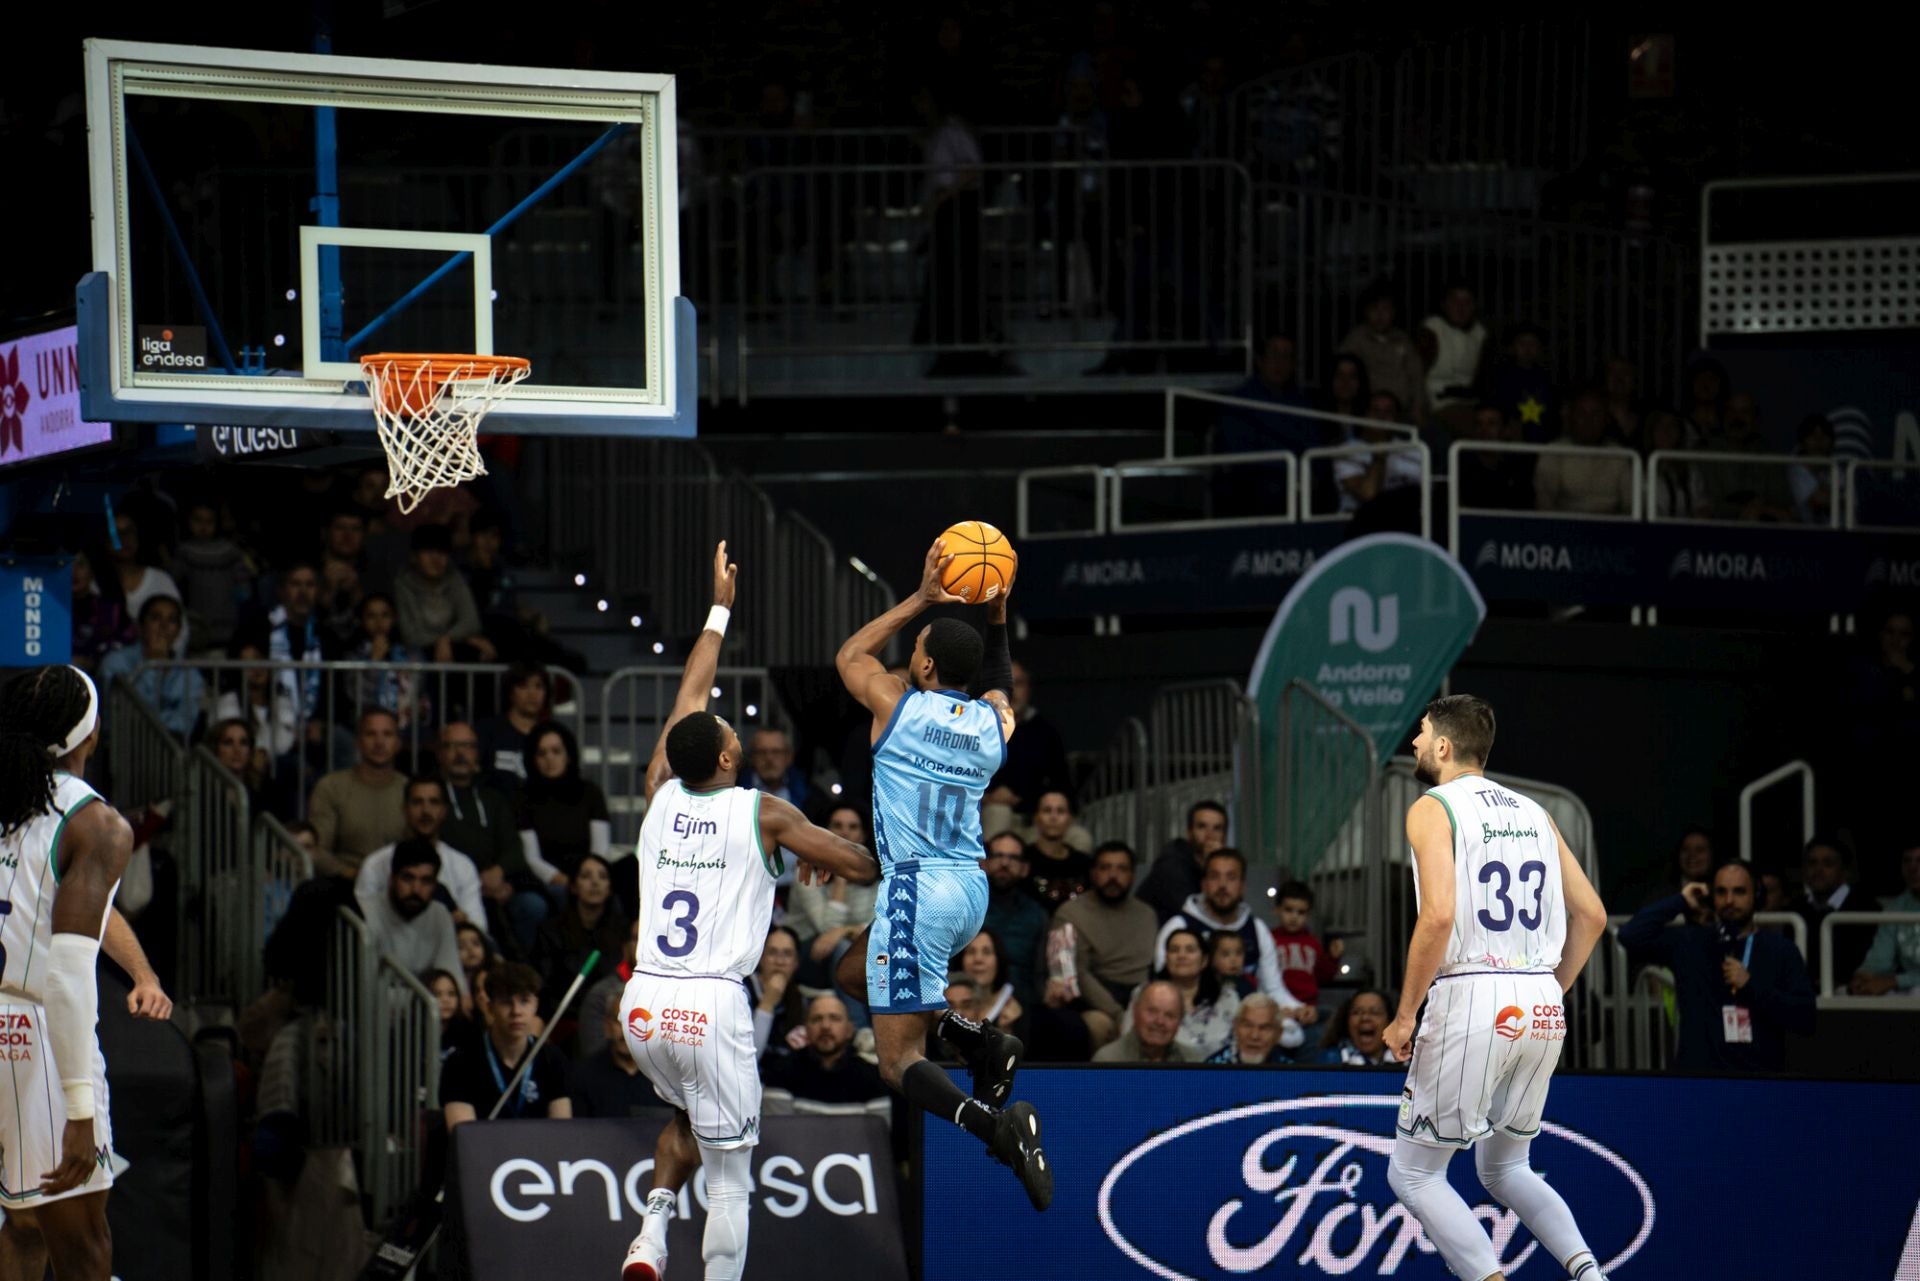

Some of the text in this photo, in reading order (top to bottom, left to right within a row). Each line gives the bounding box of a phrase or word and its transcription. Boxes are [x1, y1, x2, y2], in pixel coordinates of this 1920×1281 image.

[142, 337, 171, 353] liga
[143, 353, 205, 367] endesa
[23, 577, 43, 656] MONDO
[1317, 663, 1411, 682] Andorra
[1347, 685, 1405, 705] Vella
[923, 726, 980, 751] HARDING
[914, 757, 986, 778] MORABANC
[1475, 789, 1520, 808] Tillie
[673, 812, 717, 839] Ejim
[917, 781, 967, 850] 10
[1477, 860, 1547, 932] 33
[656, 890, 700, 957] 3
[661, 1008, 708, 1025] COSTA
[1532, 1020, 1553, 1030] DEL
[660, 1021, 706, 1037] DEL SOL
[490, 1153, 878, 1222] endsa
